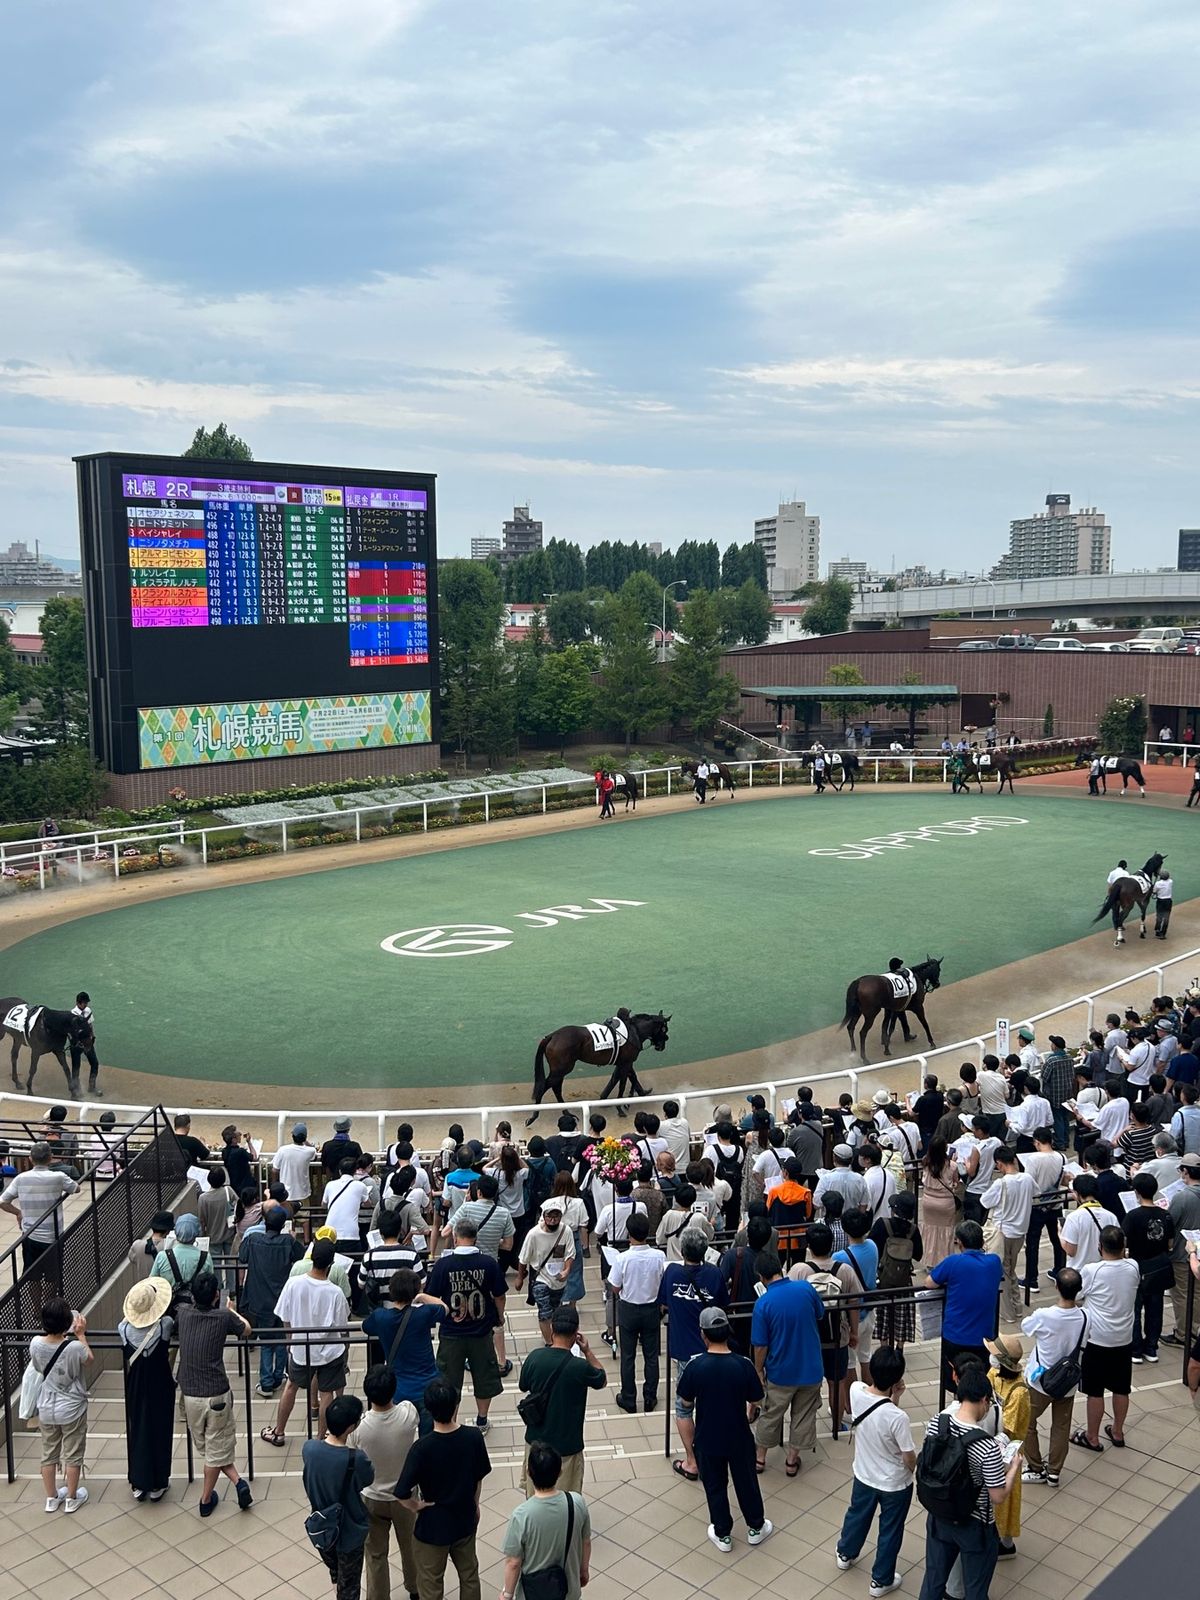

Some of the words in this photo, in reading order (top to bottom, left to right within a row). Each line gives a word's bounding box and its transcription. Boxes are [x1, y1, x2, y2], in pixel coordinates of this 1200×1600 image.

[127, 479, 156, 496] 札幌
[166, 482, 189, 498] 2R
[304, 495, 322, 504] 10:20
[207, 512, 217, 520] 452
[138, 519, 188, 528] ロードサミット
[207, 522, 217, 530] 496
[209, 551, 219, 559] 450
[209, 560, 219, 568] 440
[209, 570, 219, 578] 512
[209, 579, 220, 587] 442
[210, 598, 221, 606] 472
[192, 711, 304, 752] 札幌競馬
[808, 815, 1029, 860] SAPPORO
[514, 898, 649, 928] JRA
[890, 978, 904, 991] 10
[8, 1006, 23, 1022] 12
[592, 1028, 607, 1043] 11
[450, 1290, 485, 1322] 90
